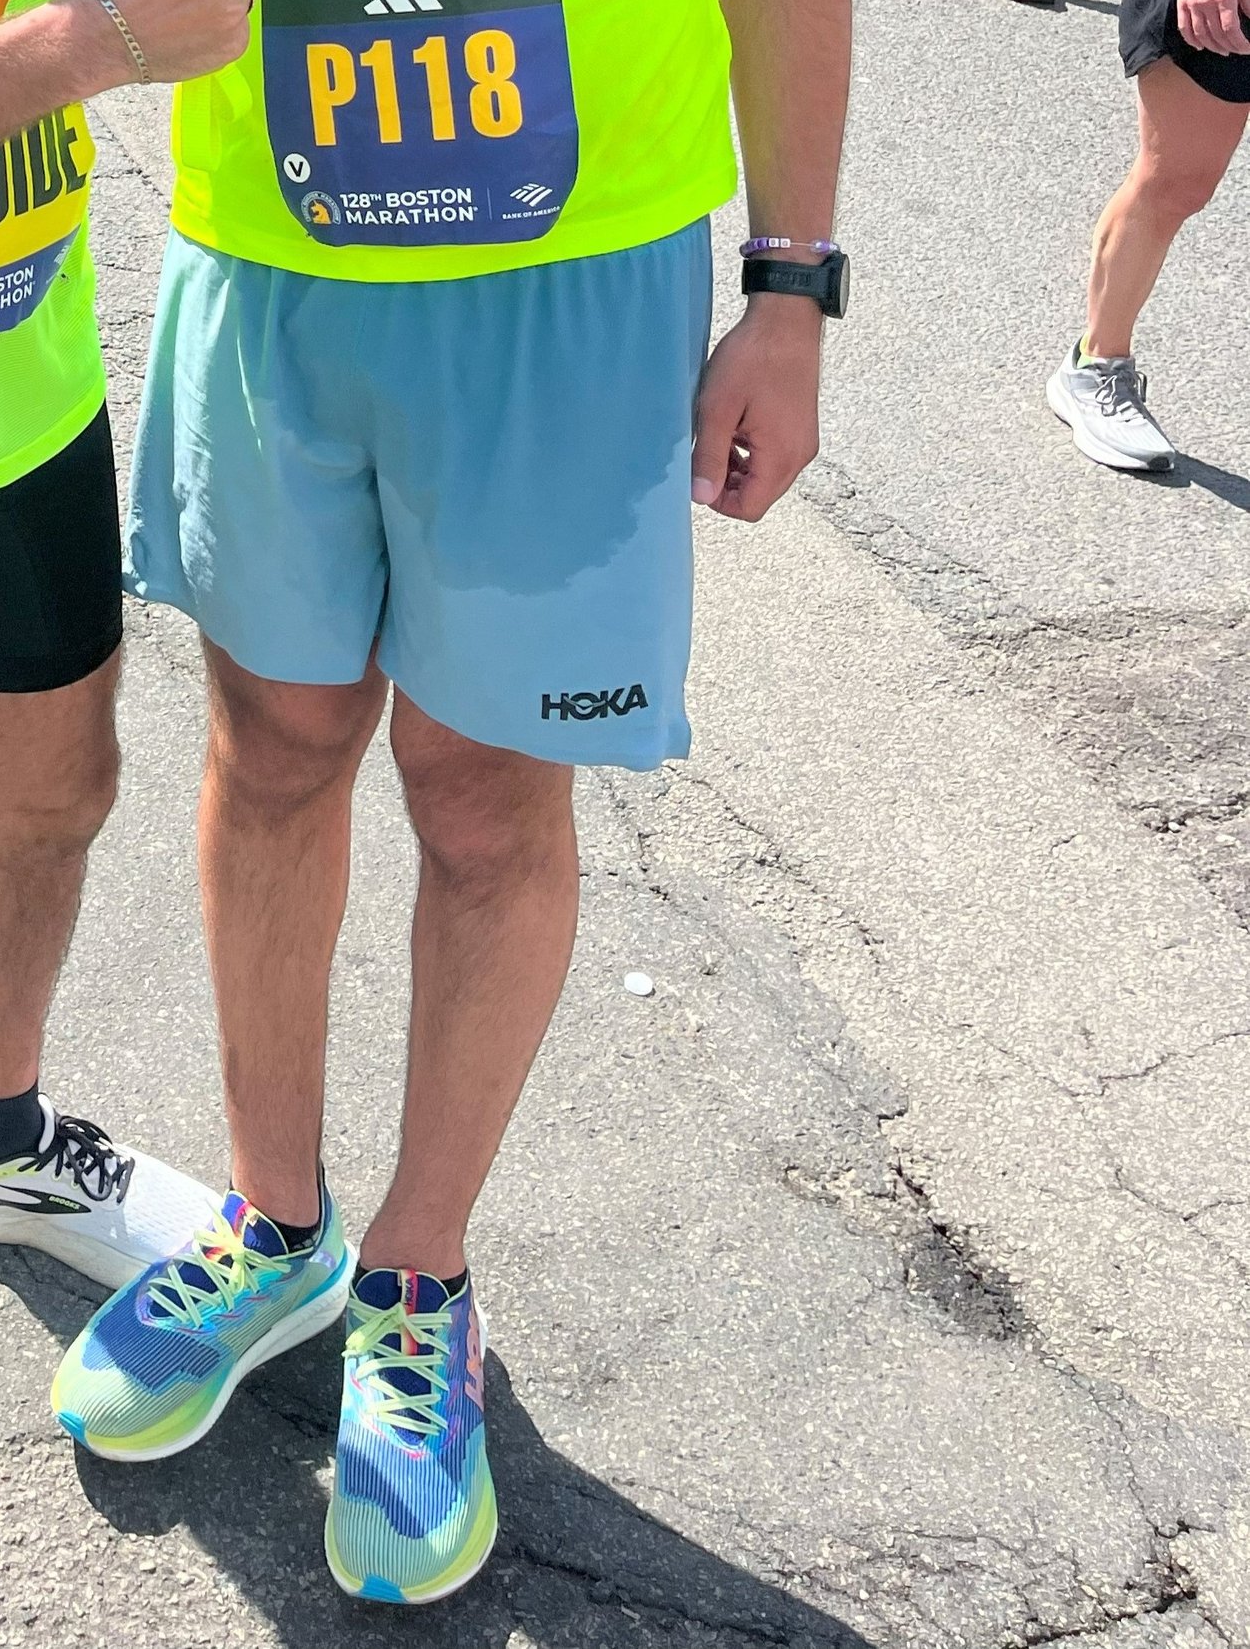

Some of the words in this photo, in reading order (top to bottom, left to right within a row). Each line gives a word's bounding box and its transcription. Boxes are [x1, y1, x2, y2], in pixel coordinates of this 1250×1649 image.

[306, 29, 524, 147] P118
[288, 160, 304, 178] V
[339, 193, 383, 209] 128TH
[386, 187, 473, 208] BOSTON
[502, 212, 522, 220] BANK
[541, 683, 649, 721] HOKA
